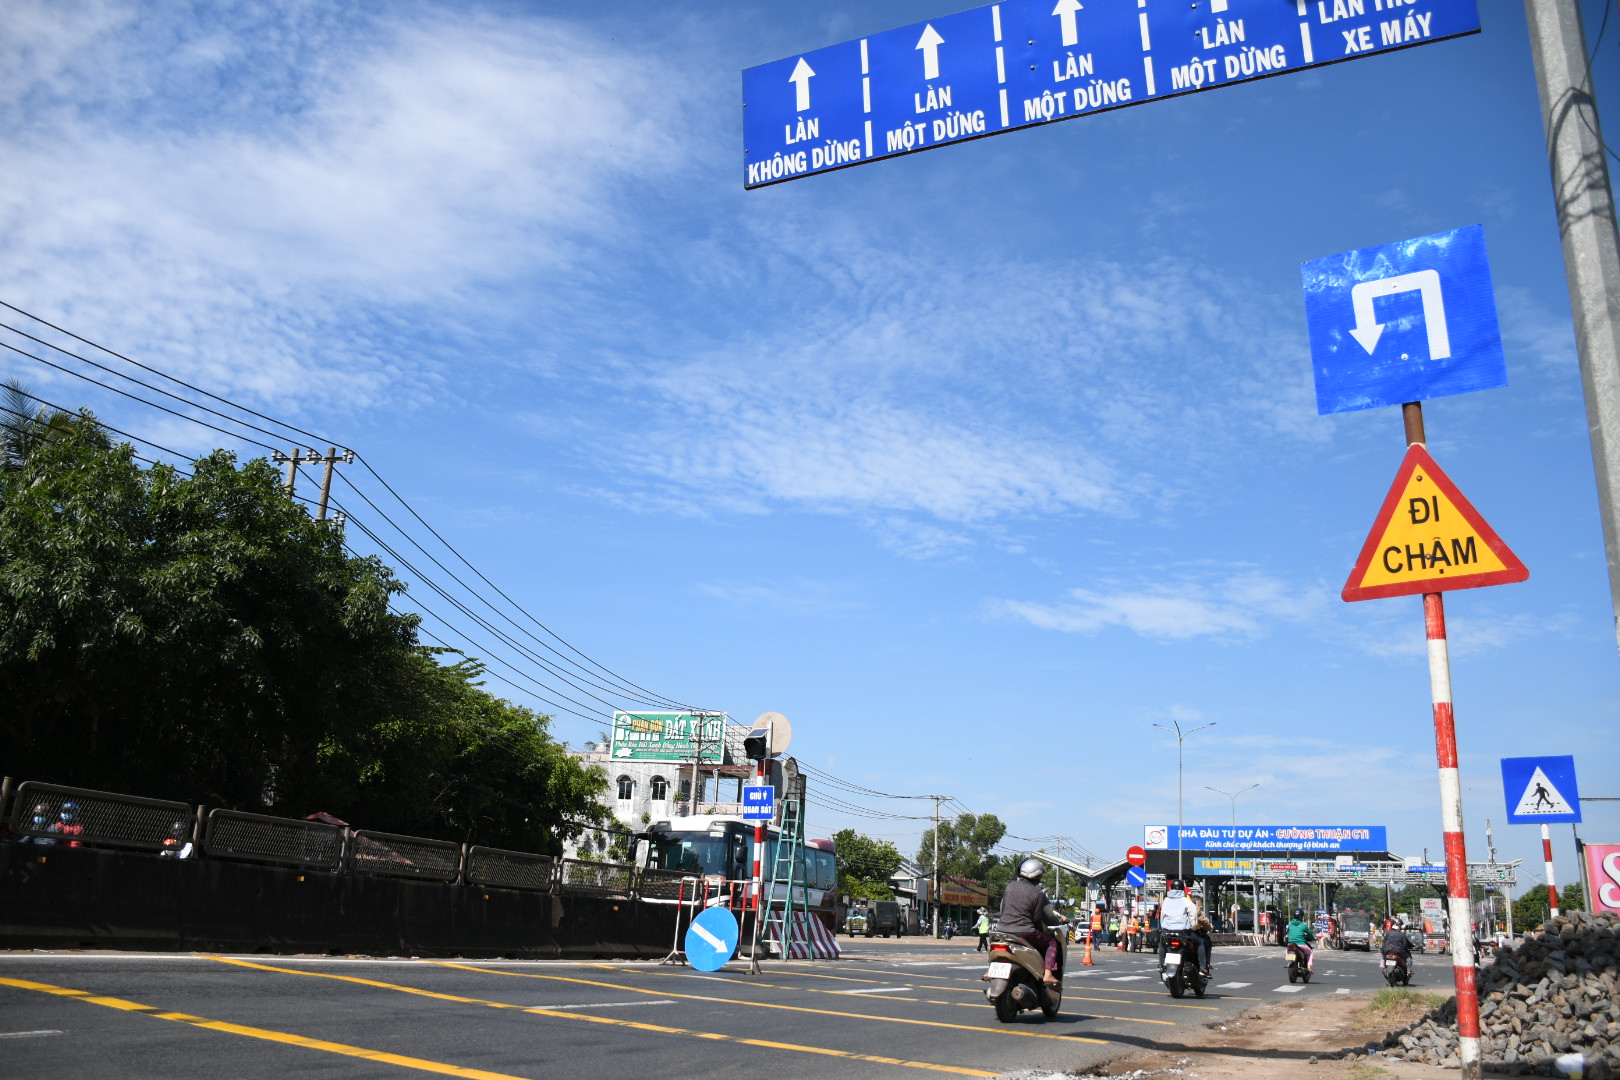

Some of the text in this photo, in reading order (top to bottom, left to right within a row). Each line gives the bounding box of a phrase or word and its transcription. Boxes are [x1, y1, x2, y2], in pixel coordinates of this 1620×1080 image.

[1202, 18, 1245, 49] LÀN
[1342, 9, 1432, 54] XE MÁY
[1053, 52, 1094, 83] LÀN
[1171, 45, 1287, 90] MỘT DỪNG
[914, 84, 952, 114] LÀN
[1024, 78, 1132, 121] MỘT DỪNG
[785, 116, 820, 145] LÀN
[886, 110, 986, 152] MỘT DỪNG
[748, 139, 861, 184] KHÔNG DỪNG
[1408, 495, 1440, 525] ĐI
[1383, 536, 1478, 574] CHẬM
[664, 714, 687, 740] ĐẤT
[1177, 828, 1198, 838] NHÀ
[1199, 828, 1220, 838] ĐẦU
[1221, 829, 1236, 838] TƯ
[1238, 829, 1254, 840] DỰ
[1255, 828, 1269, 838] ÁN
[1252, 840, 1275, 848] khách
